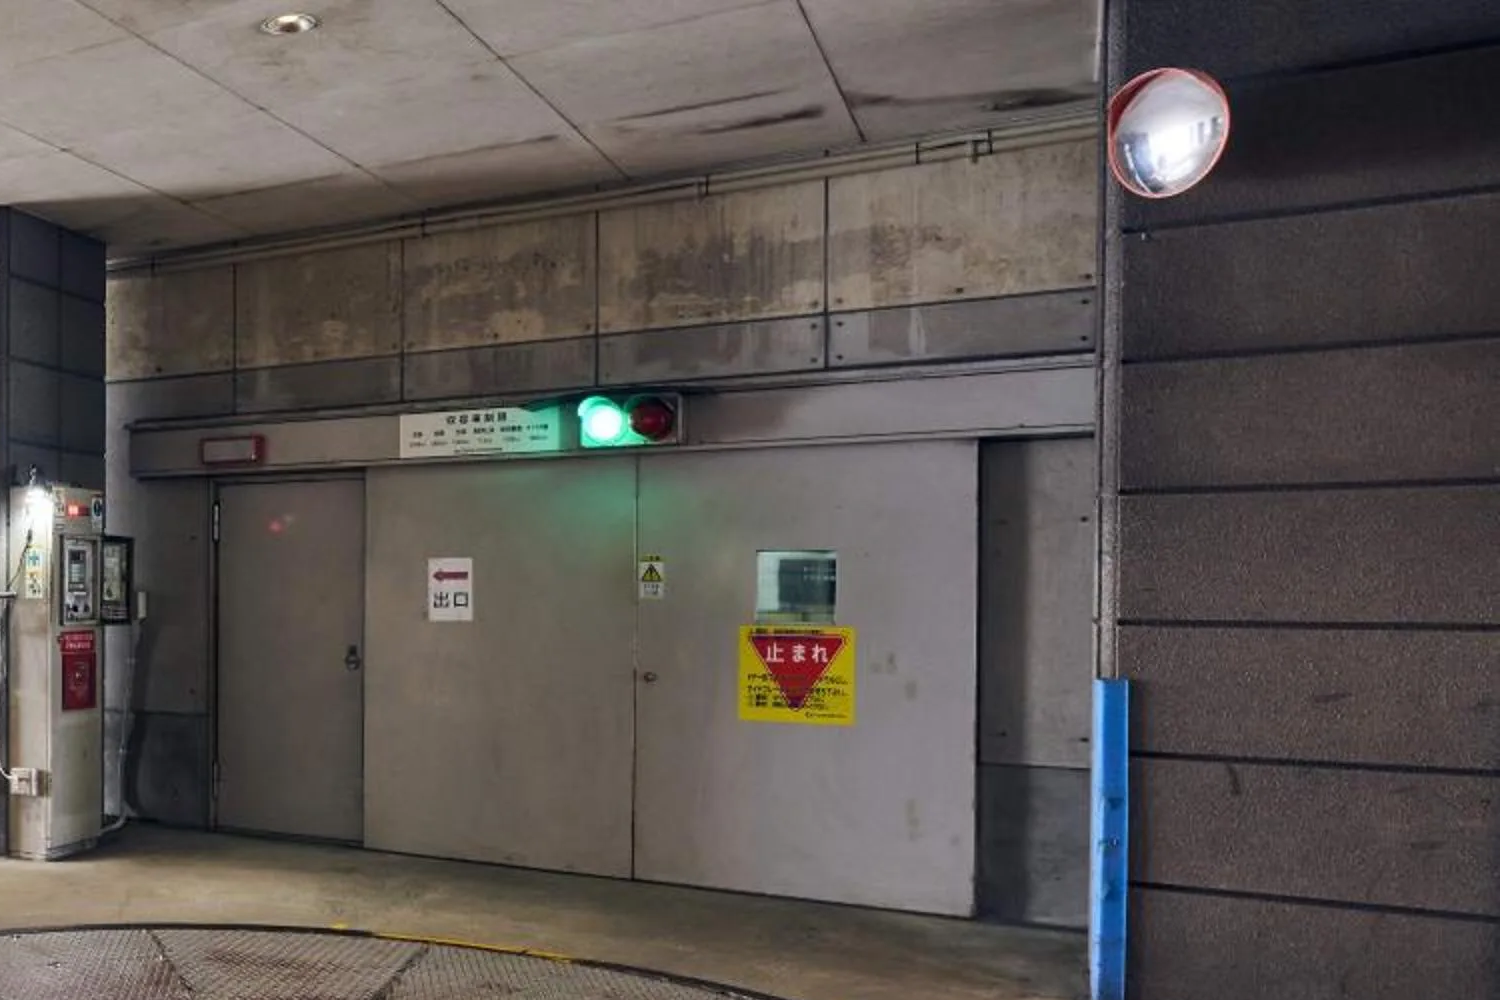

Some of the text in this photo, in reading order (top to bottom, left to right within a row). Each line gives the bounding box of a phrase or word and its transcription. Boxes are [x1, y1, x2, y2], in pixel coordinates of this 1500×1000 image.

[433, 591, 469, 608] 出口
[766, 642, 828, 663] 止まれ
